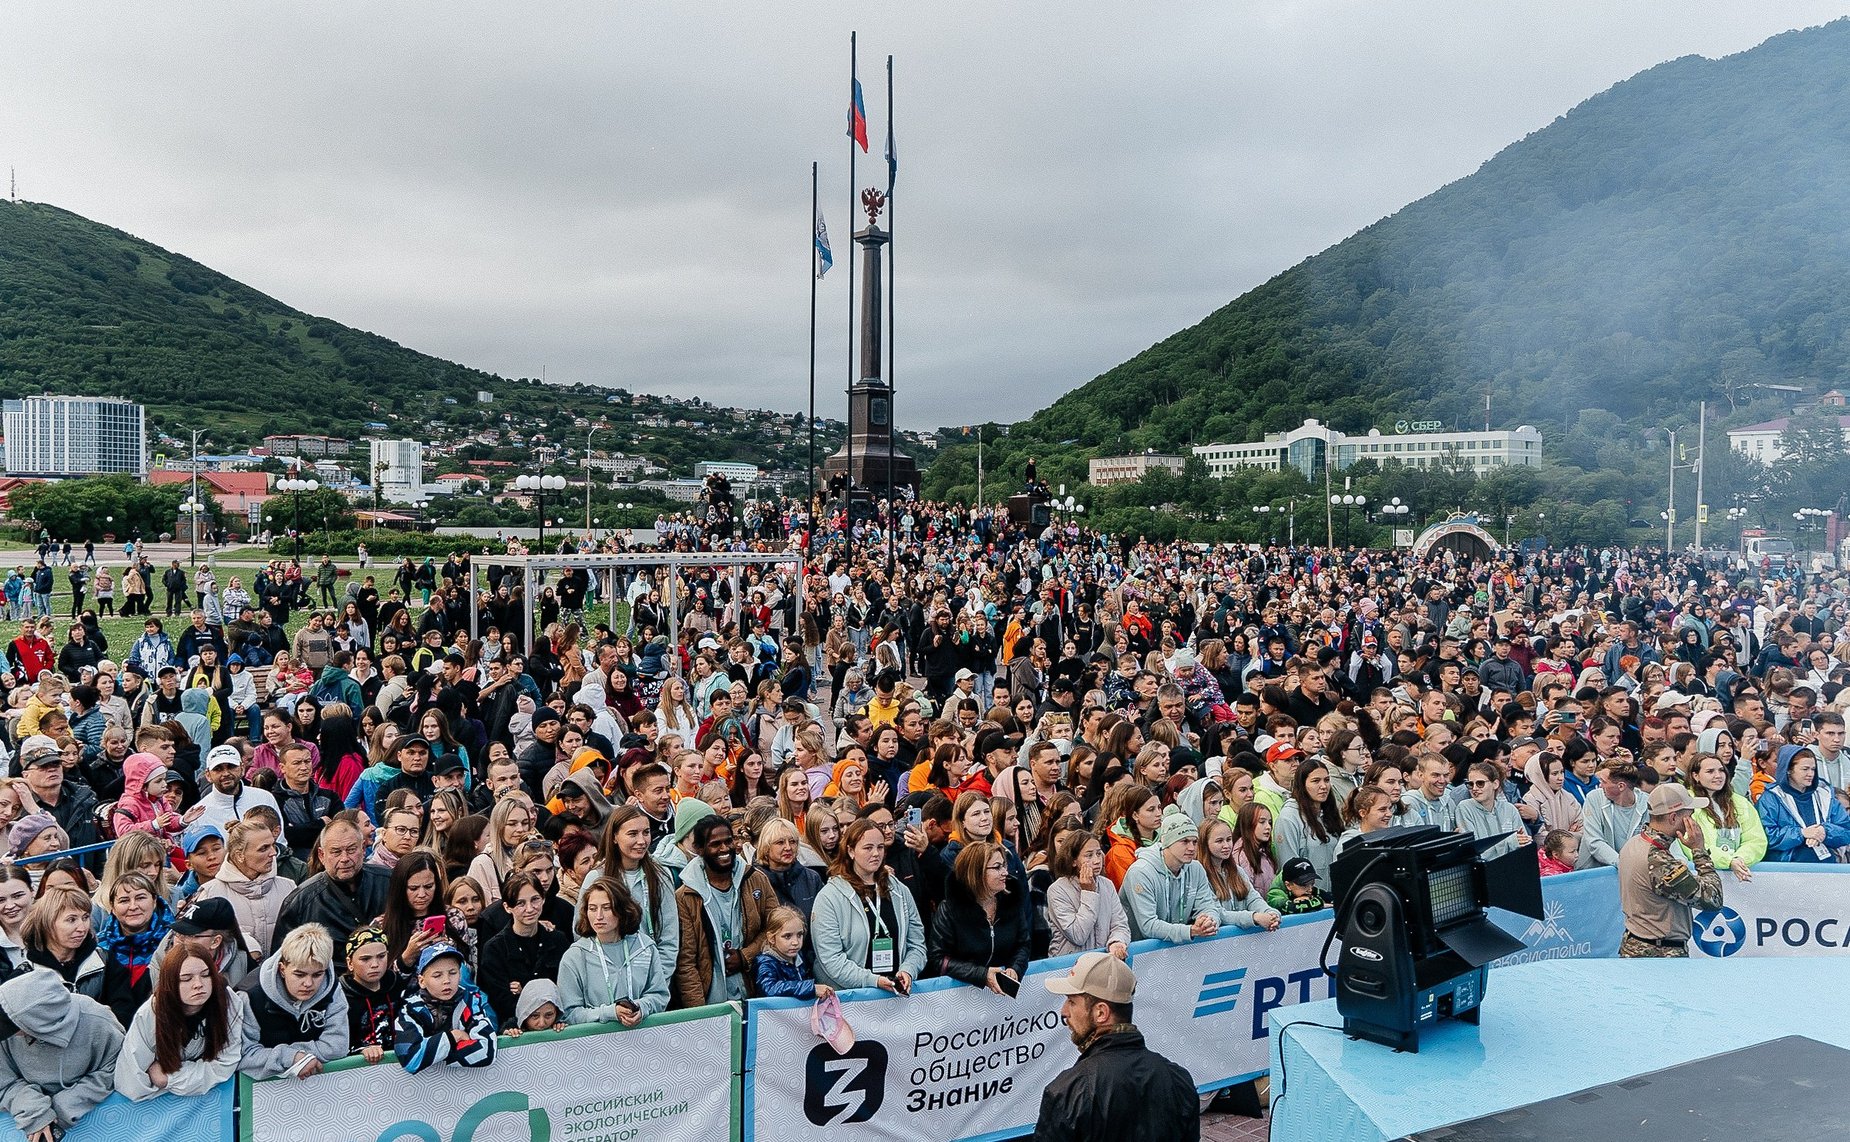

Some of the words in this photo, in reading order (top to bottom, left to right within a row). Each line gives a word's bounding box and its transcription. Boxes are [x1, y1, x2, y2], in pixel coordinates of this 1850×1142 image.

[1411, 420, 1442, 431] СБЕР
[910, 1042, 1045, 1086] общество
[564, 1088, 664, 1118] РОССИЙСКИЙ
[906, 1076, 1014, 1112] Знание
[564, 1101, 689, 1135] ЭКОЛОГИЧЕСКИЙ
